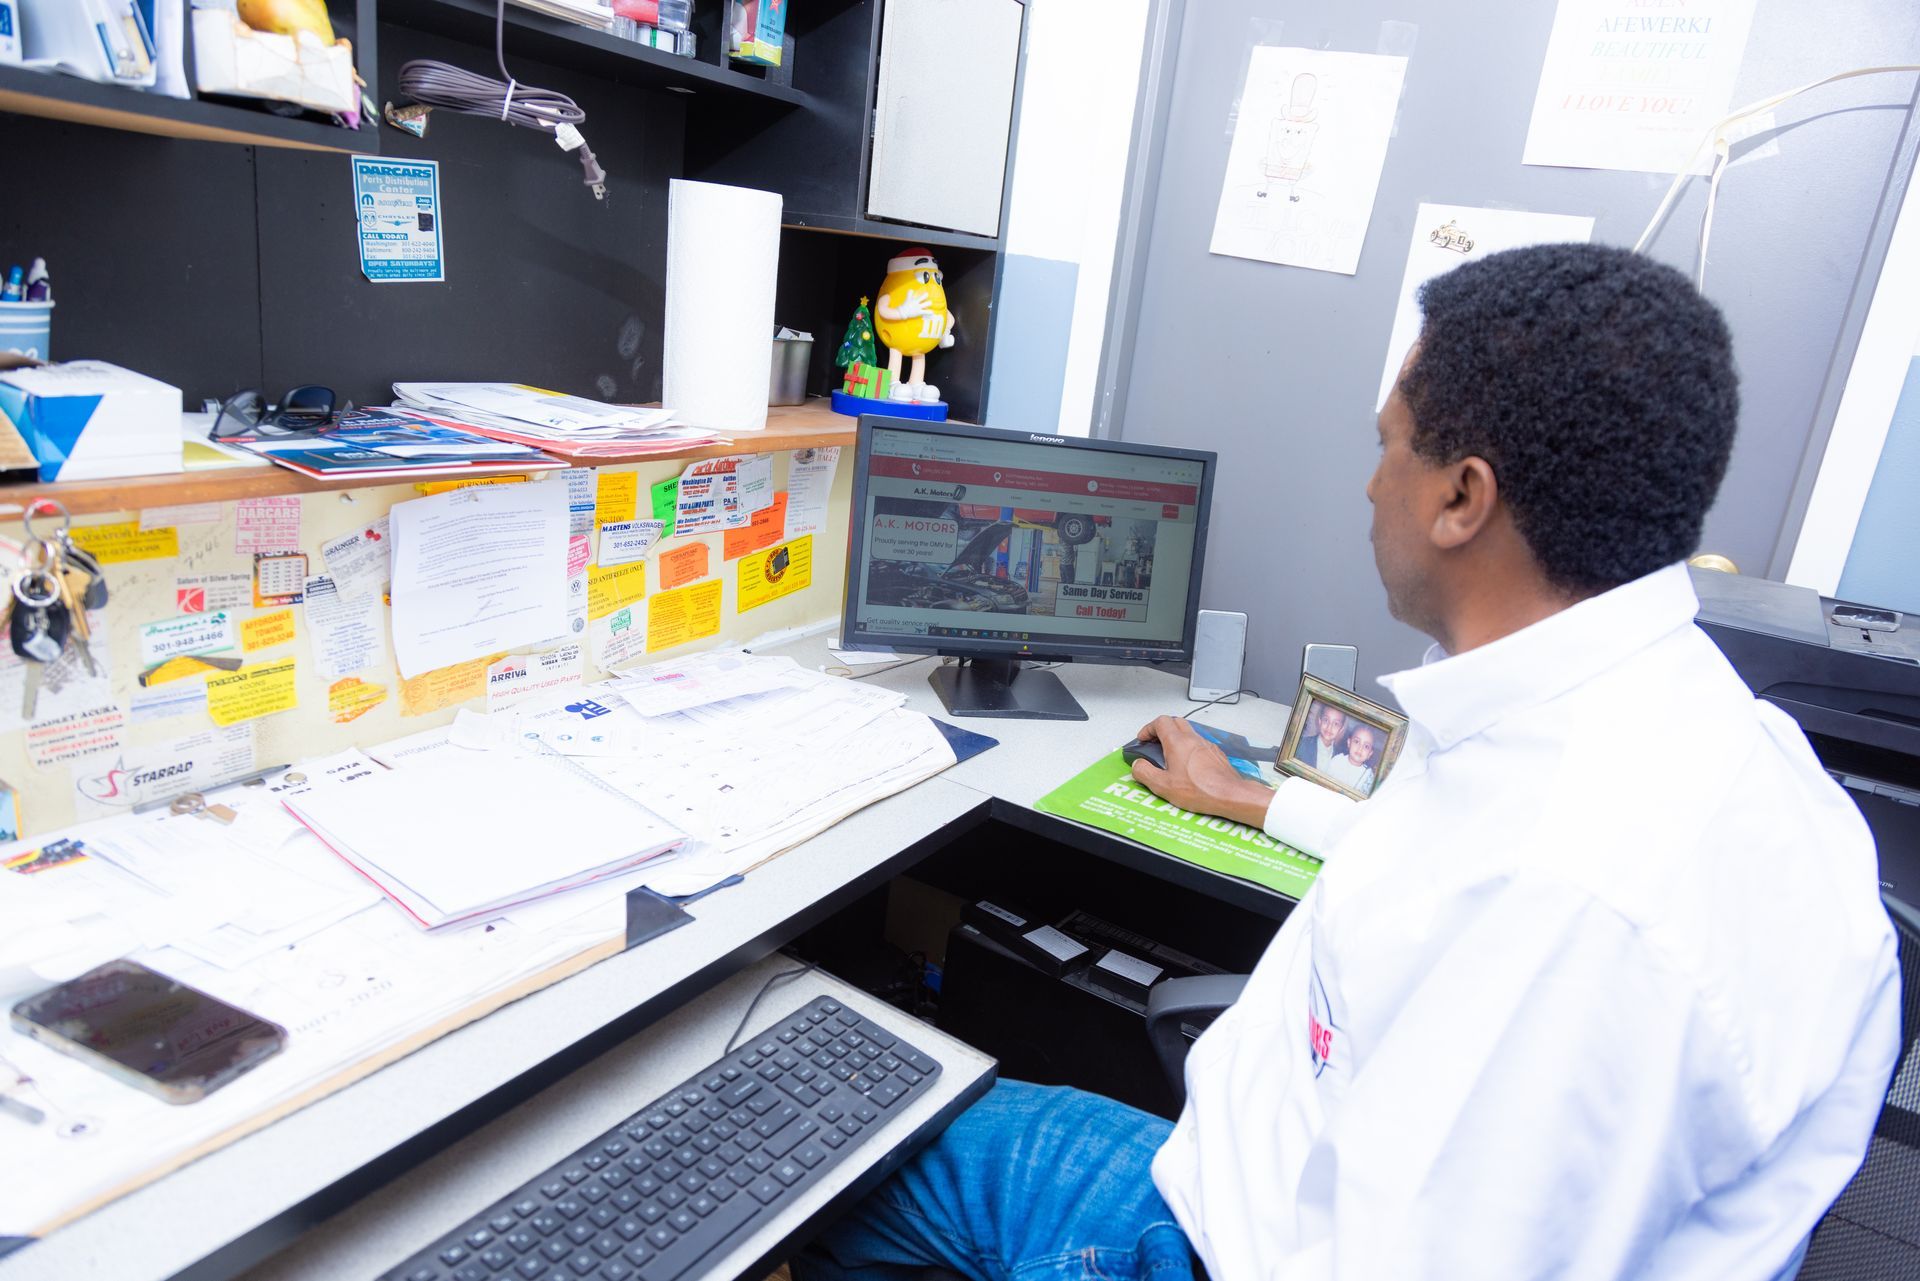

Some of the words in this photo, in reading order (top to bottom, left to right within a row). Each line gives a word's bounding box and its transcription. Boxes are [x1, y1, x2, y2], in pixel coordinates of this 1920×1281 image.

[1596, 16, 1712, 34] AFEWERKI
[1590, 41, 1708, 60] BEAUTIFUL
[1575, 95, 1634, 112] LOVE
[1640, 96, 1694, 114] YOU!
[360, 166, 432, 178] DARCARS
[363, 175, 382, 184] Parts
[385, 176, 428, 186] Distribution
[380, 185, 414, 194] Center
[1030, 434, 1064, 444] lenovo
[914, 487, 929, 496] A.K.
[930, 489, 954, 498] Motors
[239, 507, 300, 520] DARCARS
[602, 523, 631, 532] MARTENS
[874, 518, 900, 529] A.K.
[904, 520, 956, 534] MOTORS
[874, 536, 896, 545] Proudly
[630, 564, 643, 575] ONLY
[1063, 584, 1088, 598] Same
[1090, 587, 1108, 600] Day
[1110, 588, 1144, 601] Service
[1076, 604, 1093, 616] Call
[1096, 606, 1127, 619] Today!
[244, 612, 291, 630] AFFORDABLE
[207, 672, 248, 688] mazda
[490, 668, 527, 684] ARRIVA
[492, 690, 510, 700] HIGH
[511, 682, 540, 696] QUALITY
[540, 678, 560, 690] USED
[560, 673, 582, 684] PARTS
[133, 760, 194, 787] STARRAD
